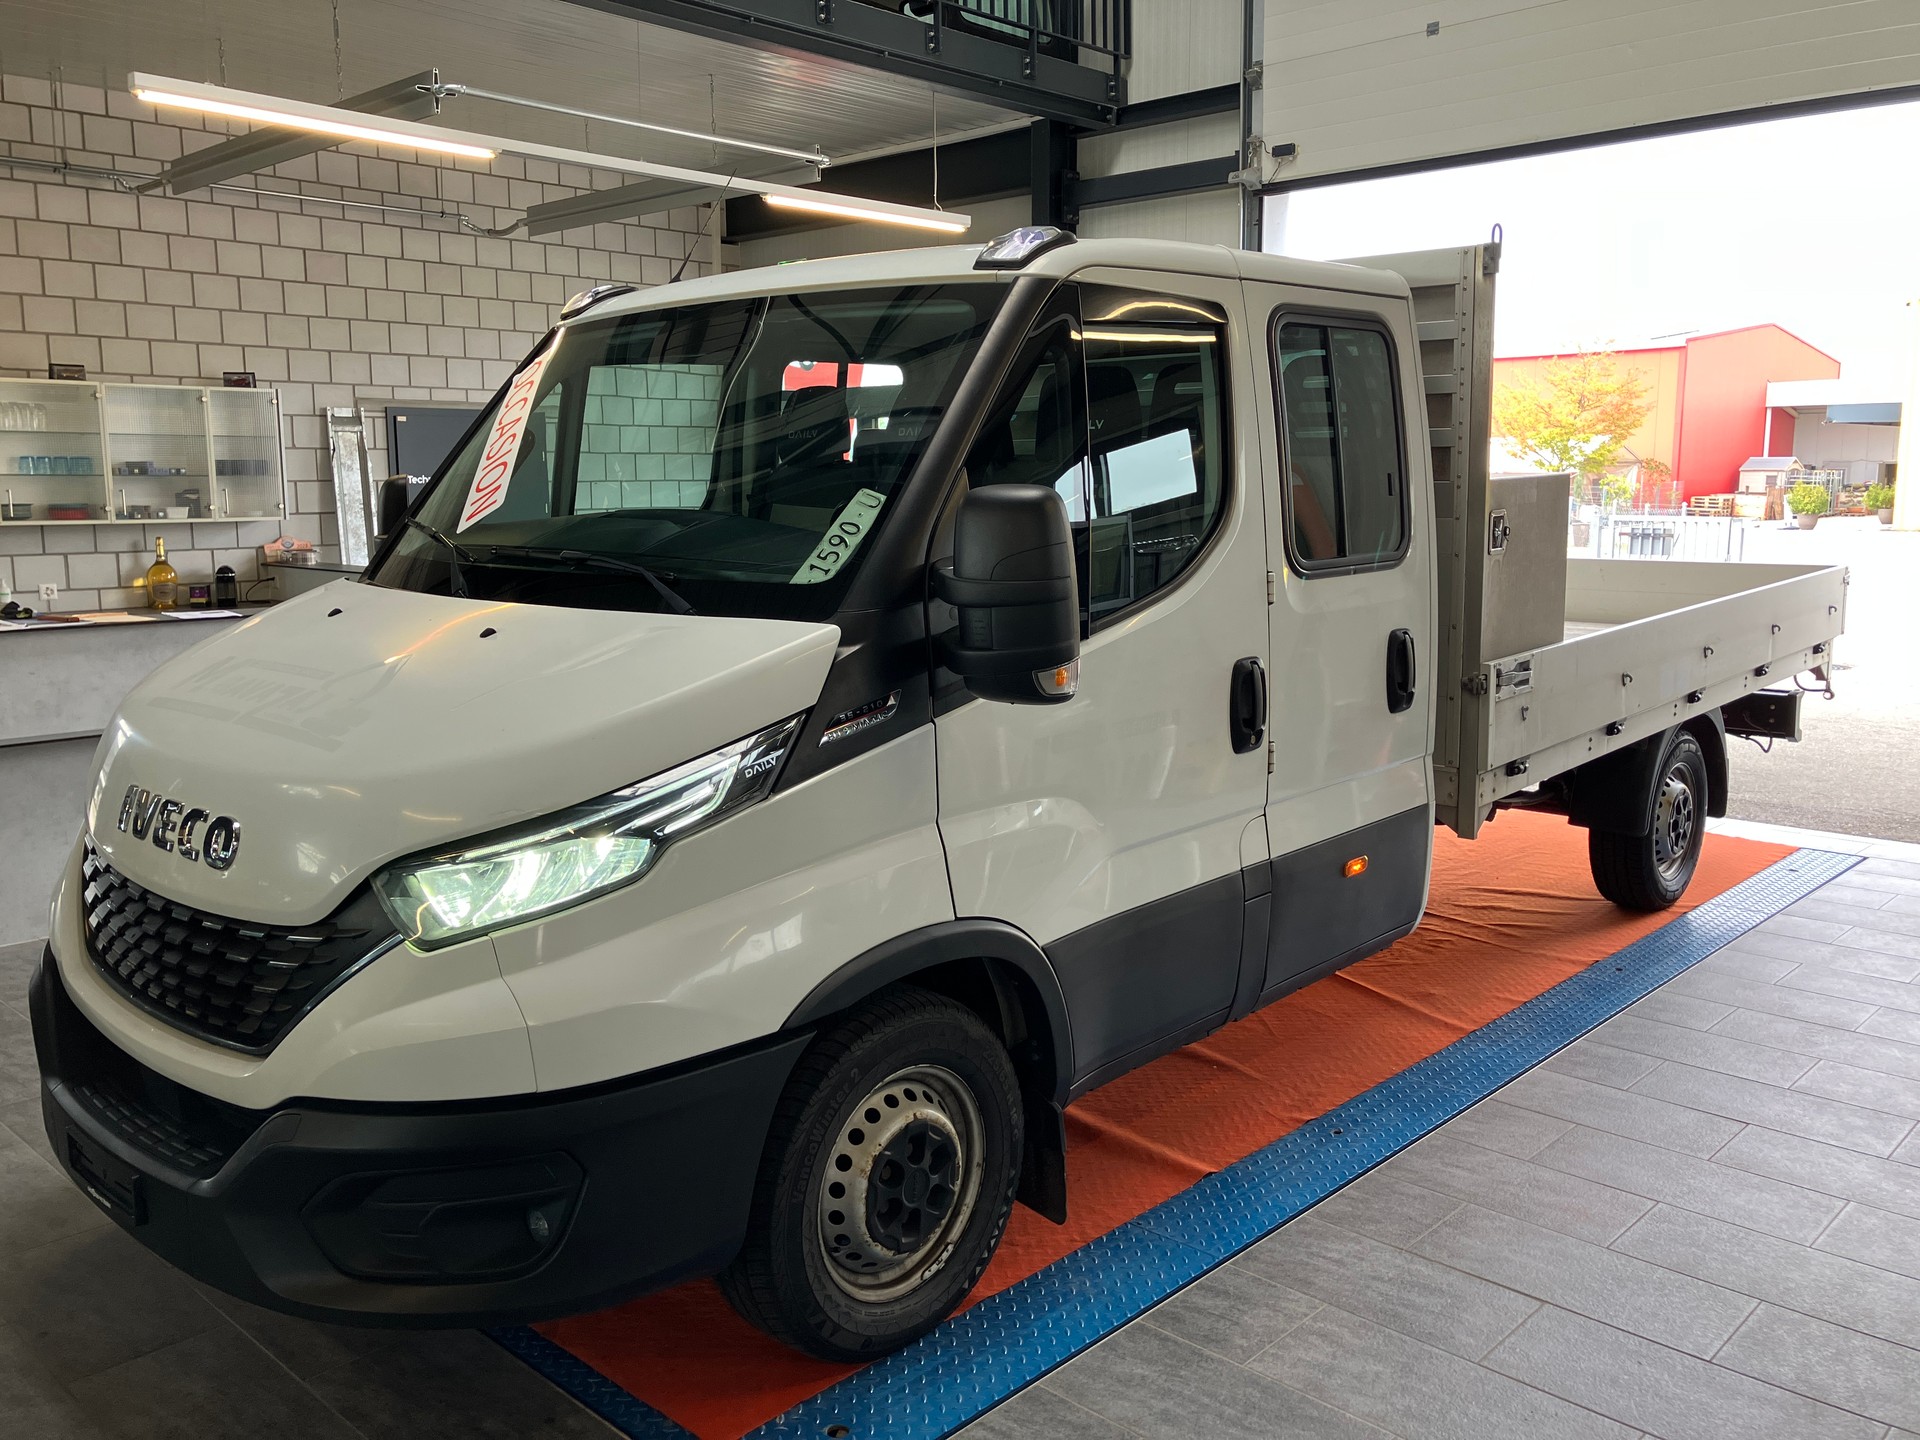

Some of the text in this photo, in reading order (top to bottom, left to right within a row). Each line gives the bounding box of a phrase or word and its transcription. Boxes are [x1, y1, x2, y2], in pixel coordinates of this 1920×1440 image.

[465, 360, 542, 523] OCCASION
[897, 427, 921, 438] DAI
[809, 491, 882, 577] 1590 U
[744, 755, 778, 779] DAILY
[117, 784, 241, 872] IVECO
